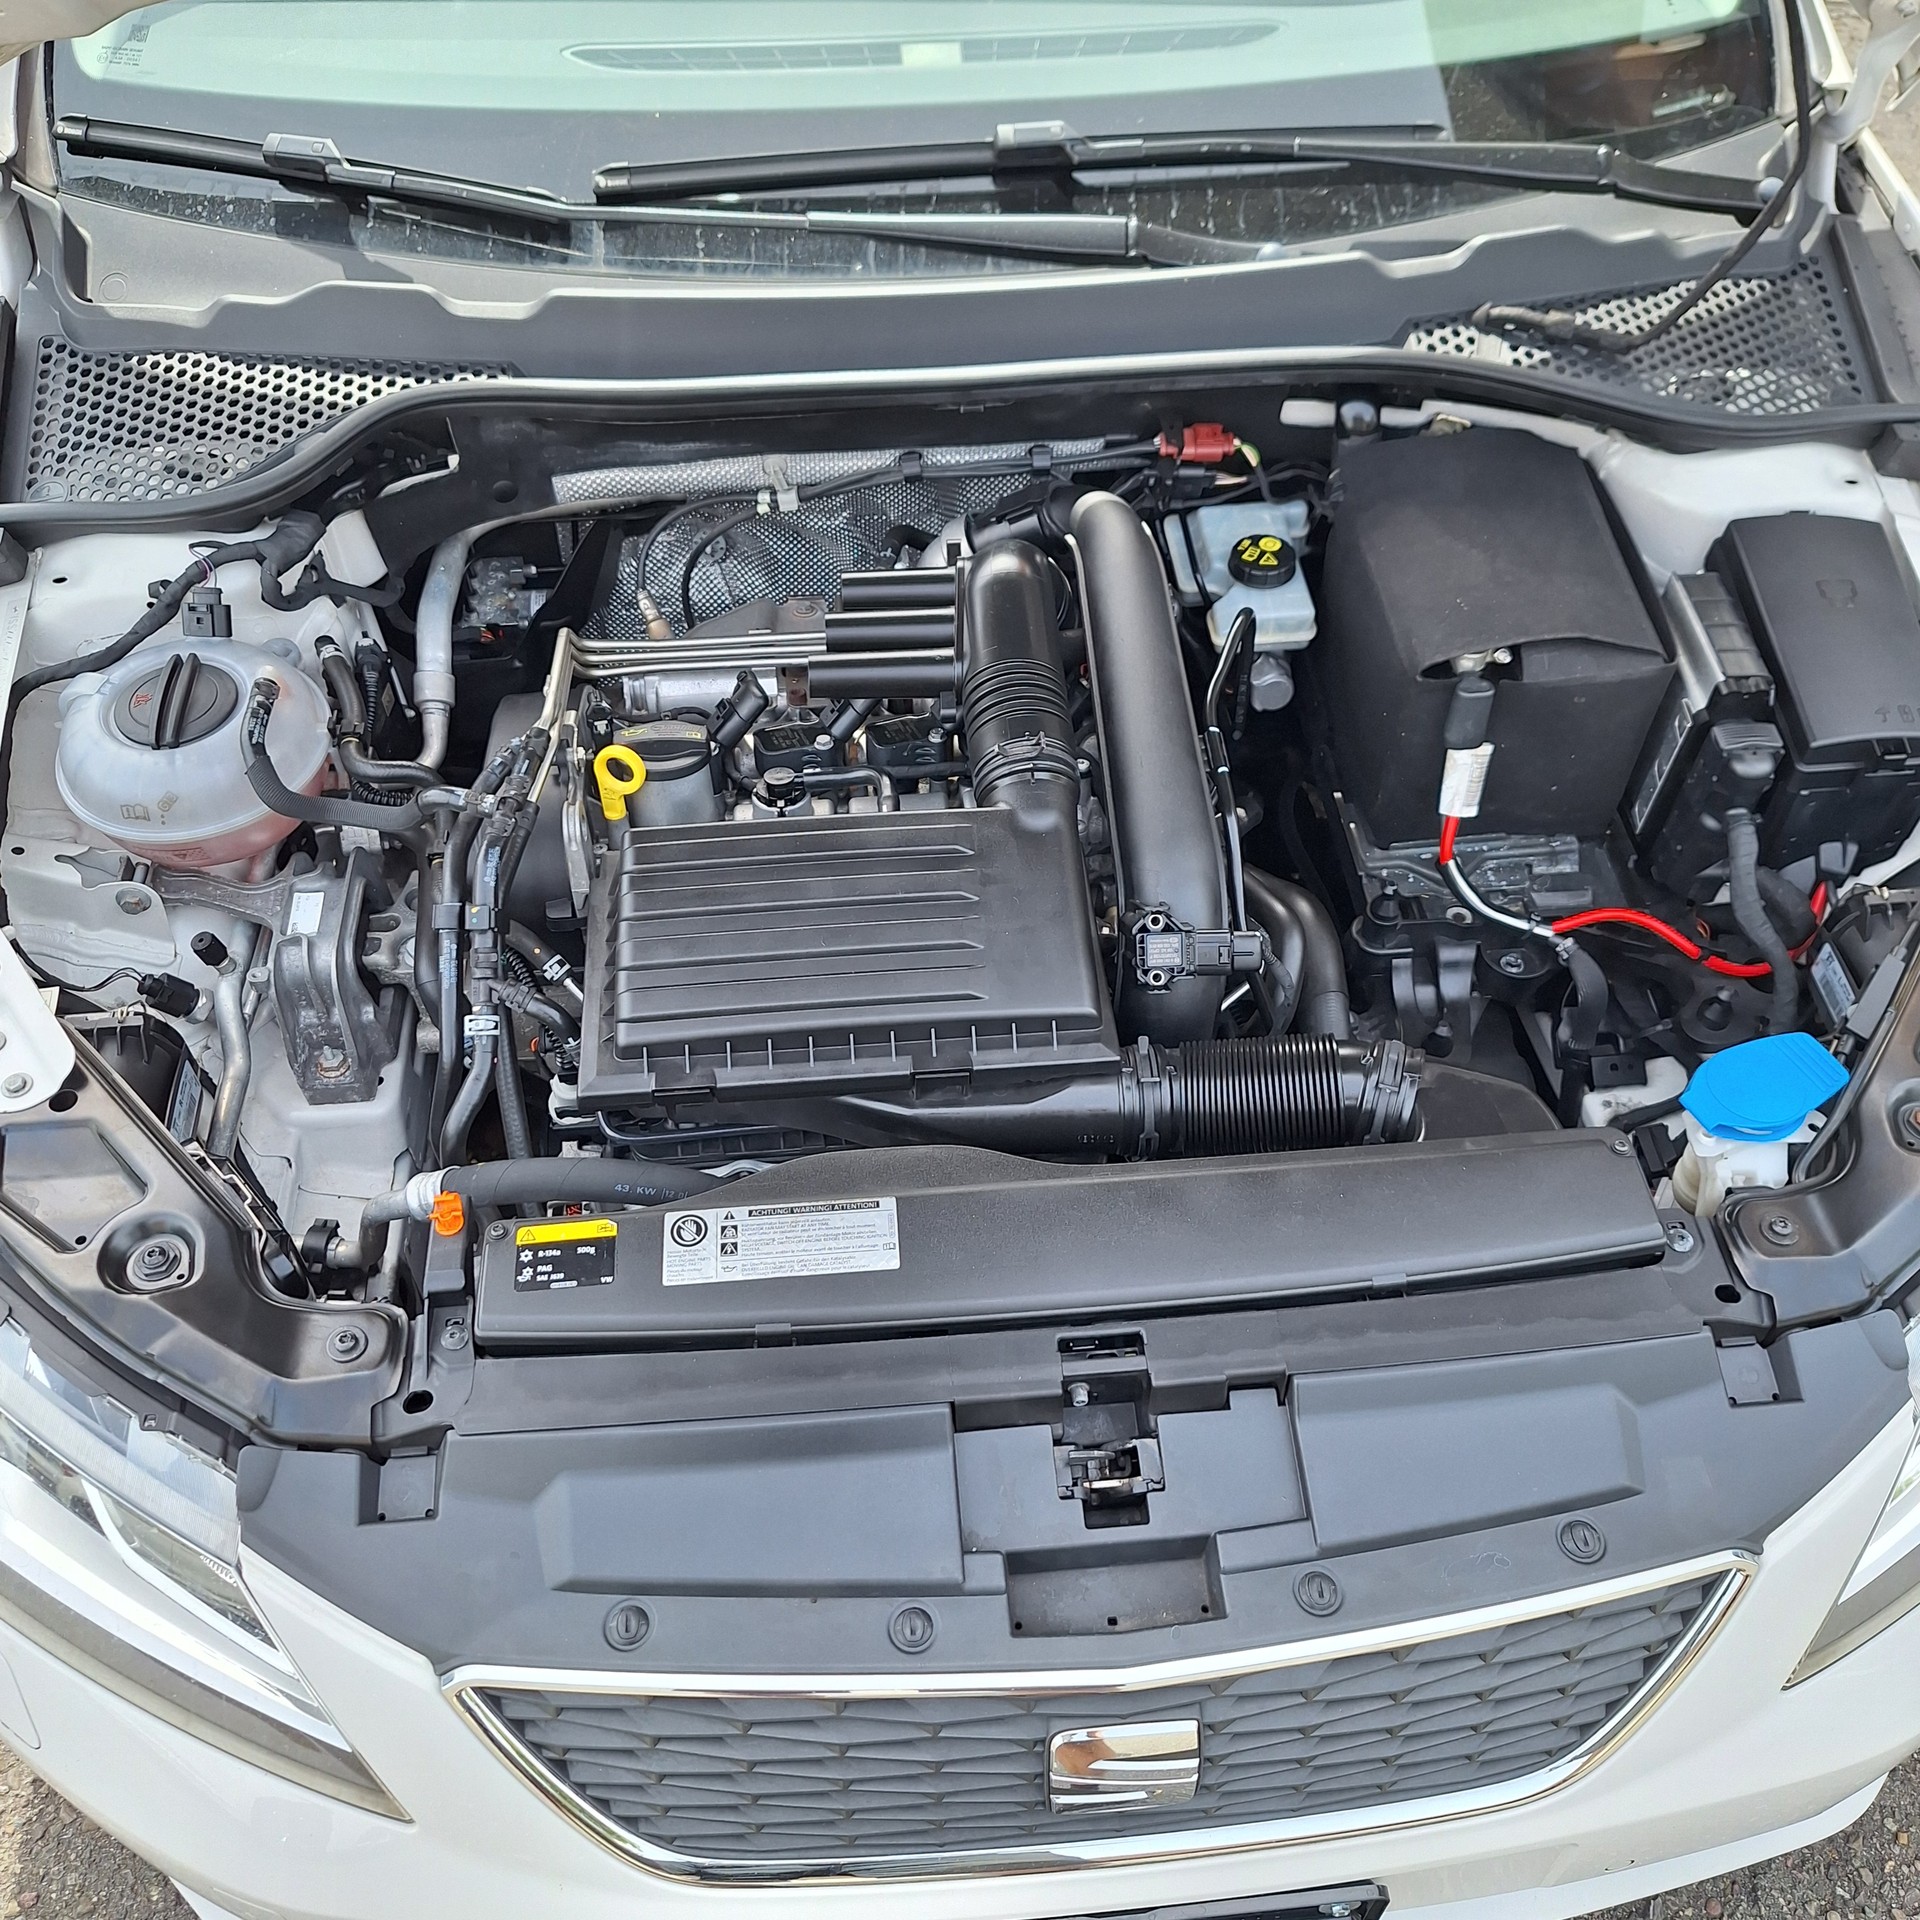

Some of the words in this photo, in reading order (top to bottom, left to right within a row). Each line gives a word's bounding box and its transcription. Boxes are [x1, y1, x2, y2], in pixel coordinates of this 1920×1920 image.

[636, 1186, 657, 1196] KW
[751, 1207, 792, 1217] ACHTUNG!
[793, 1205, 833, 1214] WARNING!
[833, 1202, 878, 1212] ATTENTION!
[538, 1249, 561, 1258] R-134a
[576, 1246, 596, 1255] 500g
[537, 1264, 553, 1273] PAG
[536, 1274, 548, 1282] SAE
[600, 1276, 614, 1284] VW
